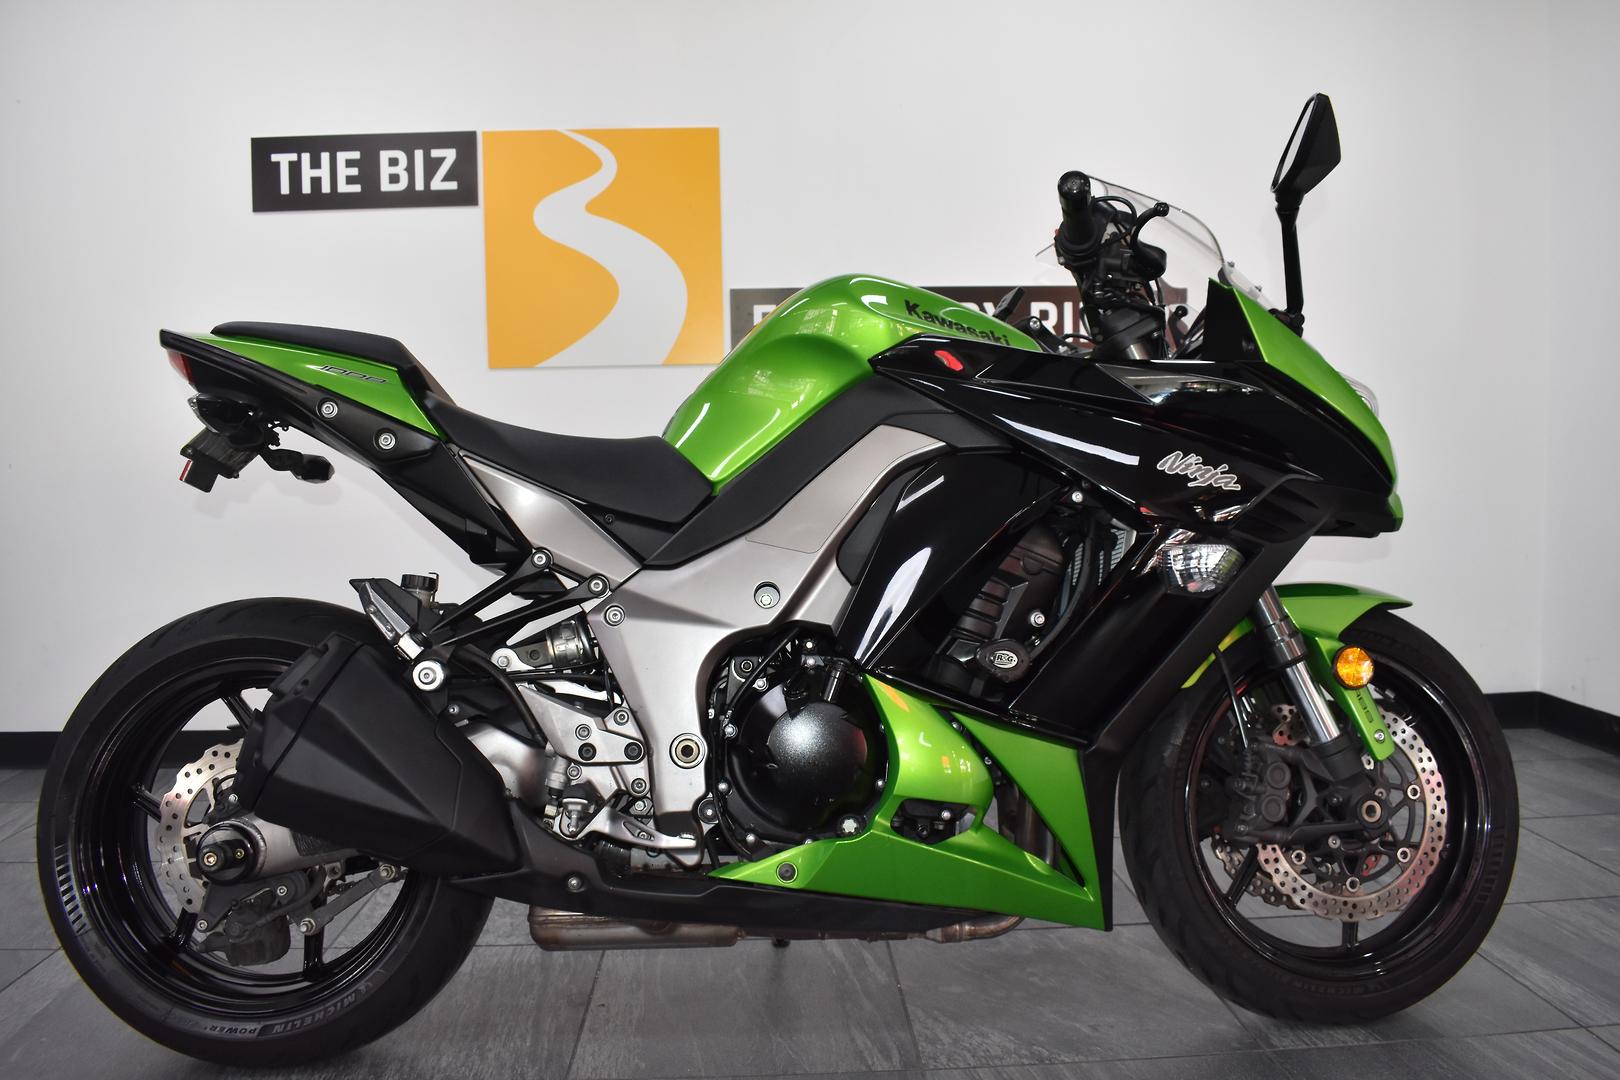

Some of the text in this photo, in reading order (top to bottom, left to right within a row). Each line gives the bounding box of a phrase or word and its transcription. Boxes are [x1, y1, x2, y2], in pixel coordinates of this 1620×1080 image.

[271, 148, 458, 195] THE BIZ
[904, 299, 1010, 346] Kawasaki
[320, 365, 387, 384] 1000
[1156, 450, 1241, 491] Ninja
[272, 993, 356, 1034] MICHELIN
